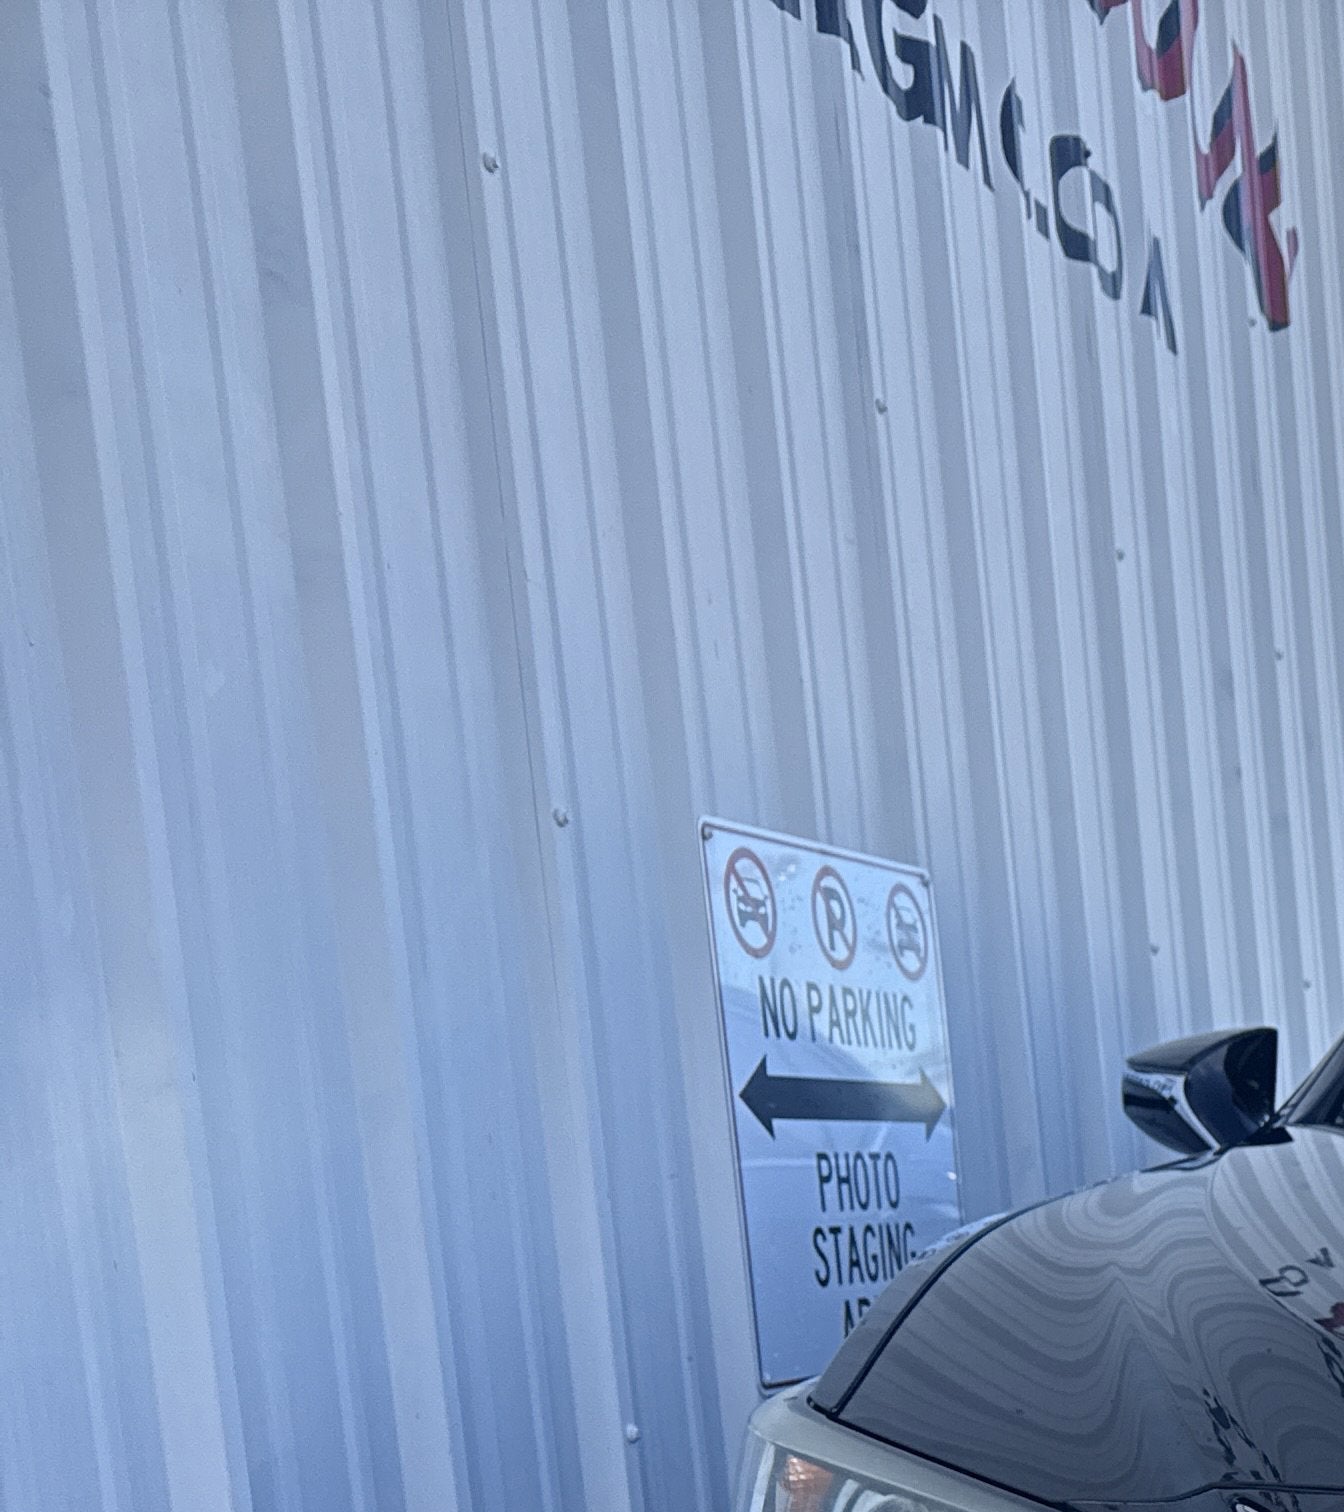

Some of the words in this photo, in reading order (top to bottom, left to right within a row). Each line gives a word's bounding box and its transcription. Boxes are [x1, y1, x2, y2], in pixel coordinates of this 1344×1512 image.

[758, 975, 798, 1041] NO
[806, 981, 917, 1051] PARKING
[816, 1151, 901, 1213] PHOTO
[812, 1221, 917, 1288] STAGING
